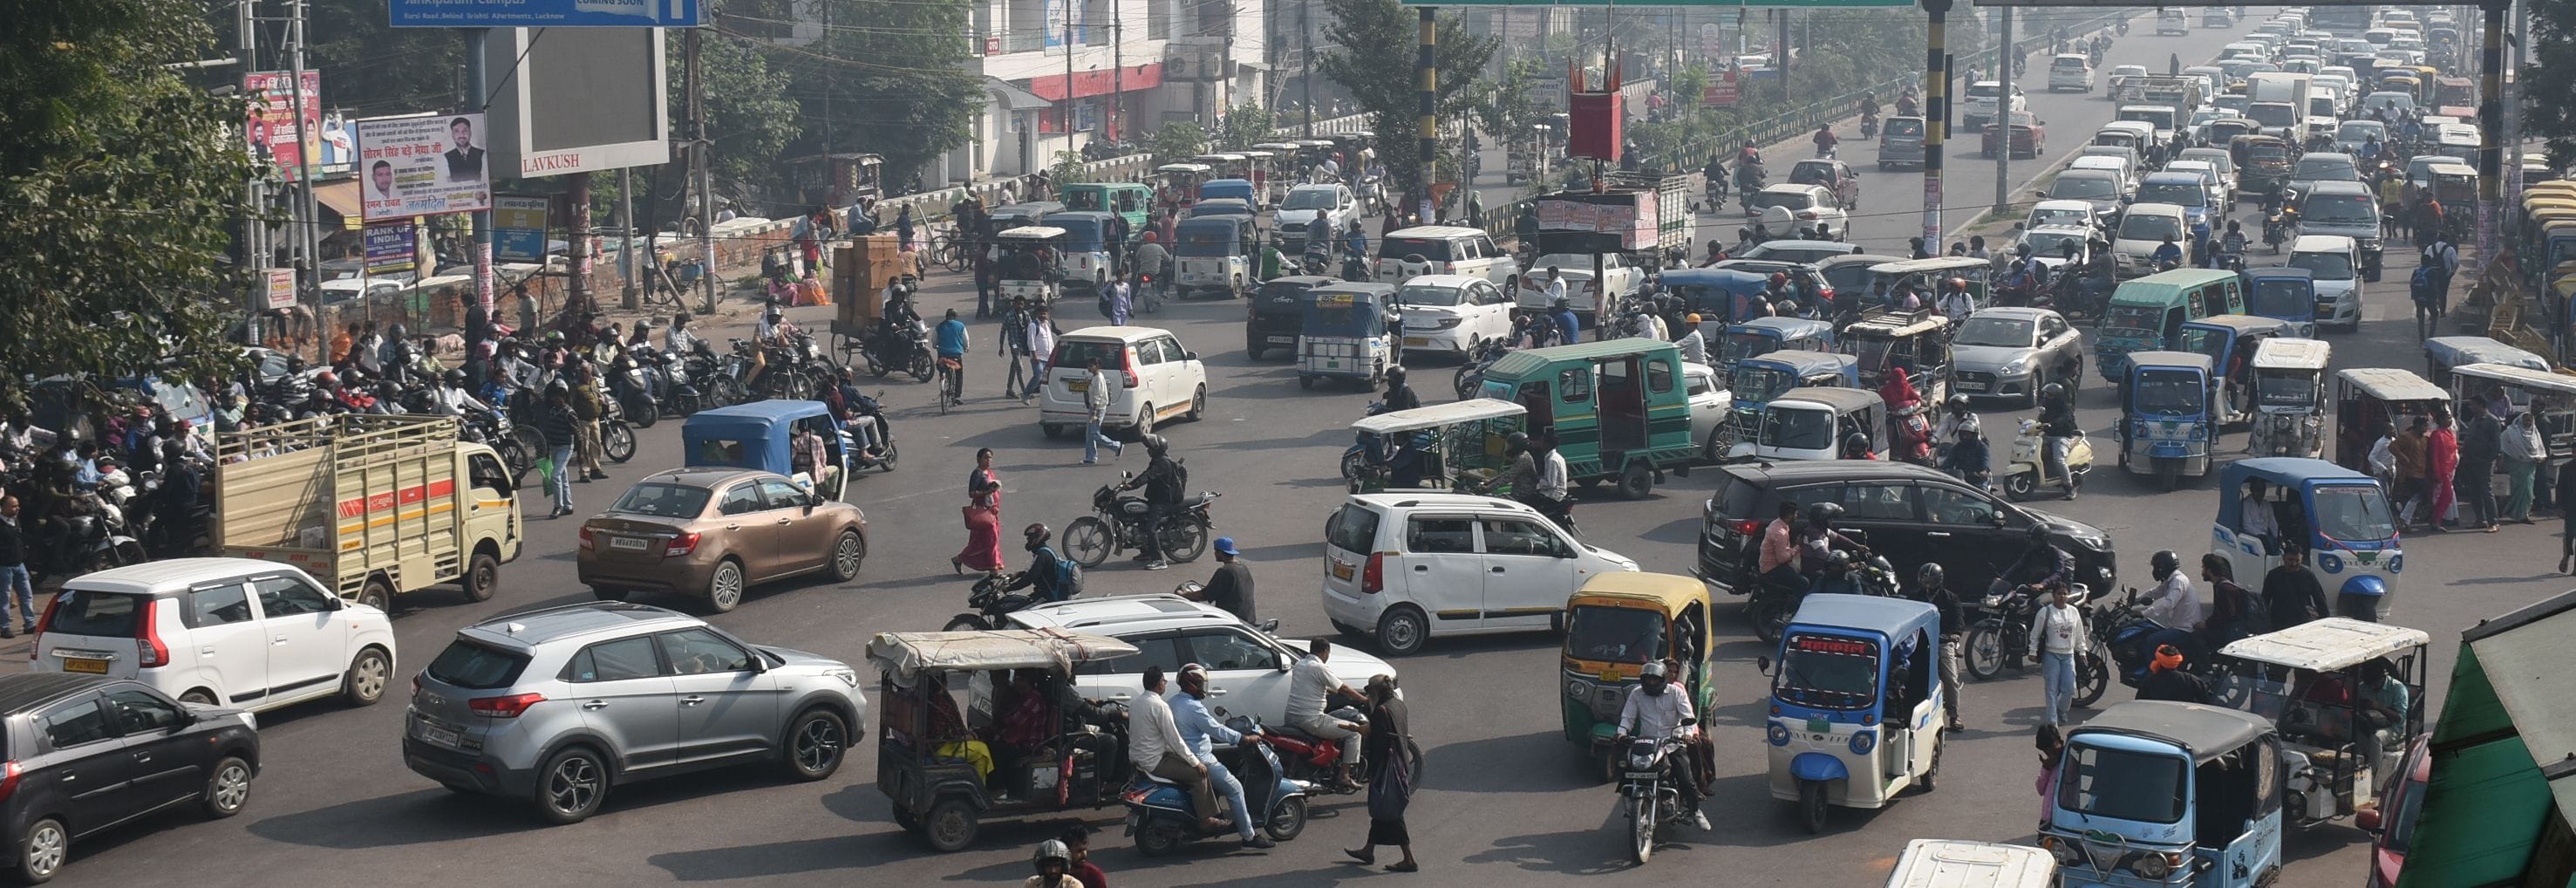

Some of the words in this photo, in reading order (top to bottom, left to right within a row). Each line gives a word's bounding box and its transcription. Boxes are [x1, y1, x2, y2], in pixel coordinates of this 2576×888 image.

[431, 141, 443, 154] जी
[523, 153, 580, 173] LAVKUSH
[405, 195, 446, 210] जन्मदिन
[528, 200, 545, 209] पुलिस
[366, 226, 395, 237] RANK
[373, 234, 402, 244] INDIA
[1798, 639, 1866, 654] महाकाल
